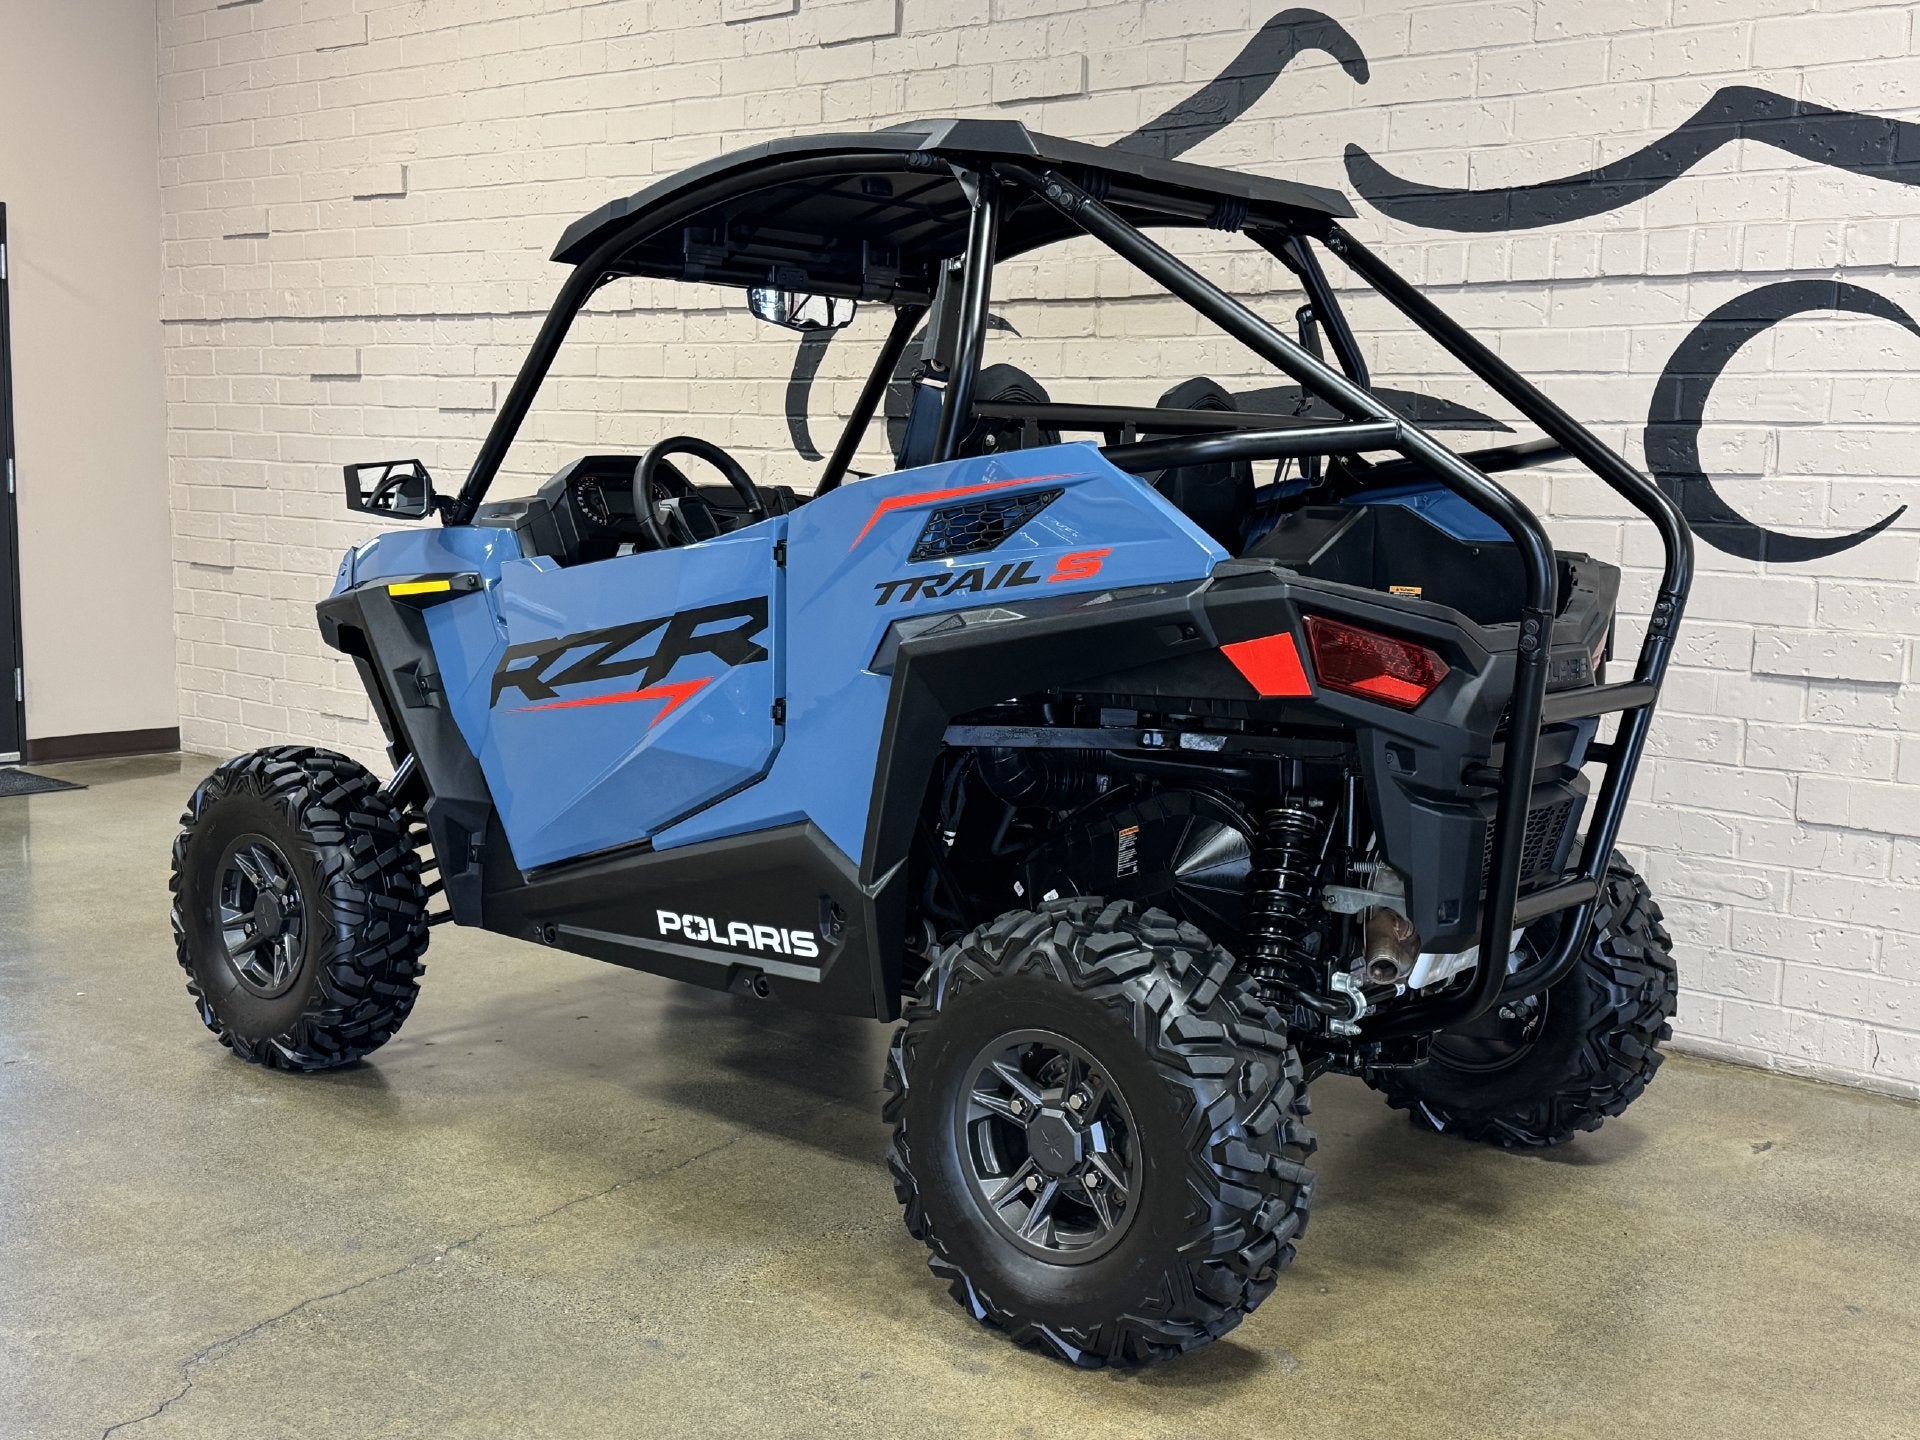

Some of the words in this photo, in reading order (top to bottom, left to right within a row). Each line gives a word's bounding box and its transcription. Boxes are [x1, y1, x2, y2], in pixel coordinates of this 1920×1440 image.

[875, 561, 1040, 606] TRAIL
[1047, 548, 1112, 583] S
[489, 595, 769, 709] RZR
[656, 909, 819, 958] POLARIS
